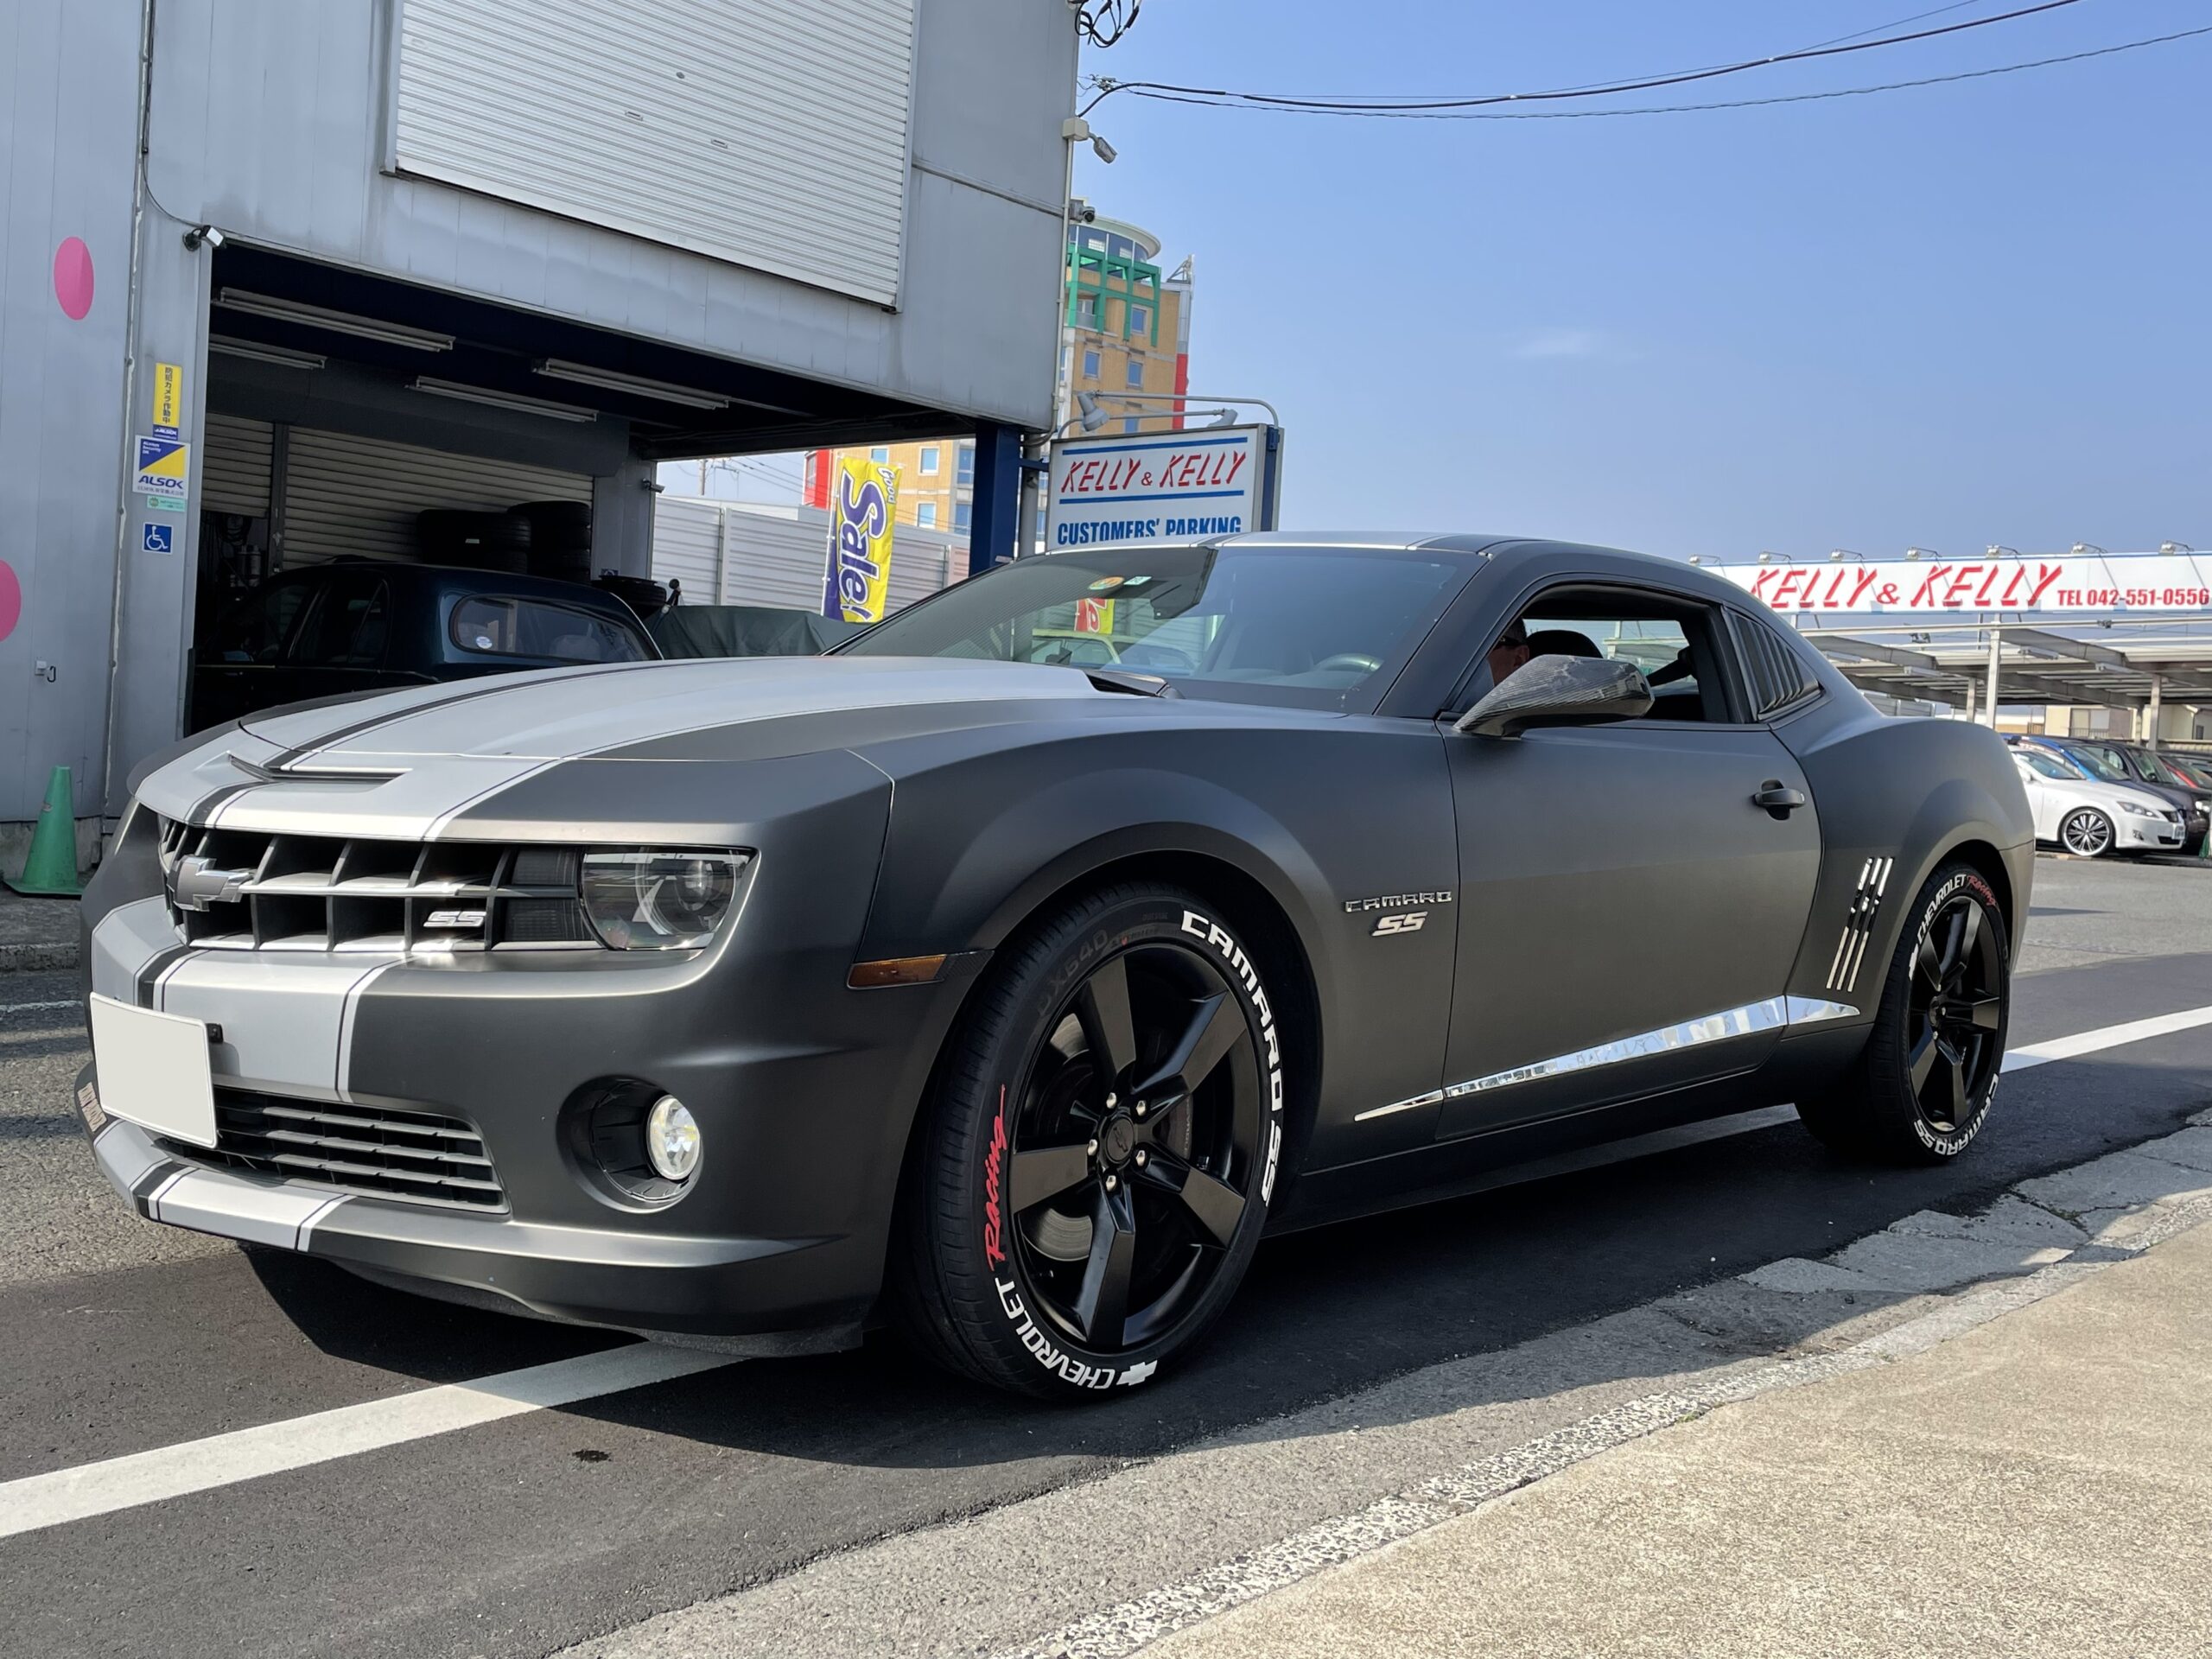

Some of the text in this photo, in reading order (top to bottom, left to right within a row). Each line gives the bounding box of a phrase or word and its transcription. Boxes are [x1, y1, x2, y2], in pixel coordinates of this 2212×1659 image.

[138, 475, 184, 490] ALSOK
[1061, 449, 1246, 493] KELLY & KELLY
[1058, 516, 1242, 545] CUSTOMERS' PARKING
[1751, 563, 2210, 608] KELLY & KELLY TEL 042-551-0556
[423, 911, 487, 927] SS
[1344, 891, 1452, 913] CAMARO
[1371, 911, 1429, 937] SS
[1917, 874, 1967, 945] CHEVROLET
[1181, 910, 1284, 1207] CAMARO SS
[1914, 1073, 1999, 1156] CAMARO SS
[984, 1084, 1116, 1389] CHEVROLET Racing
